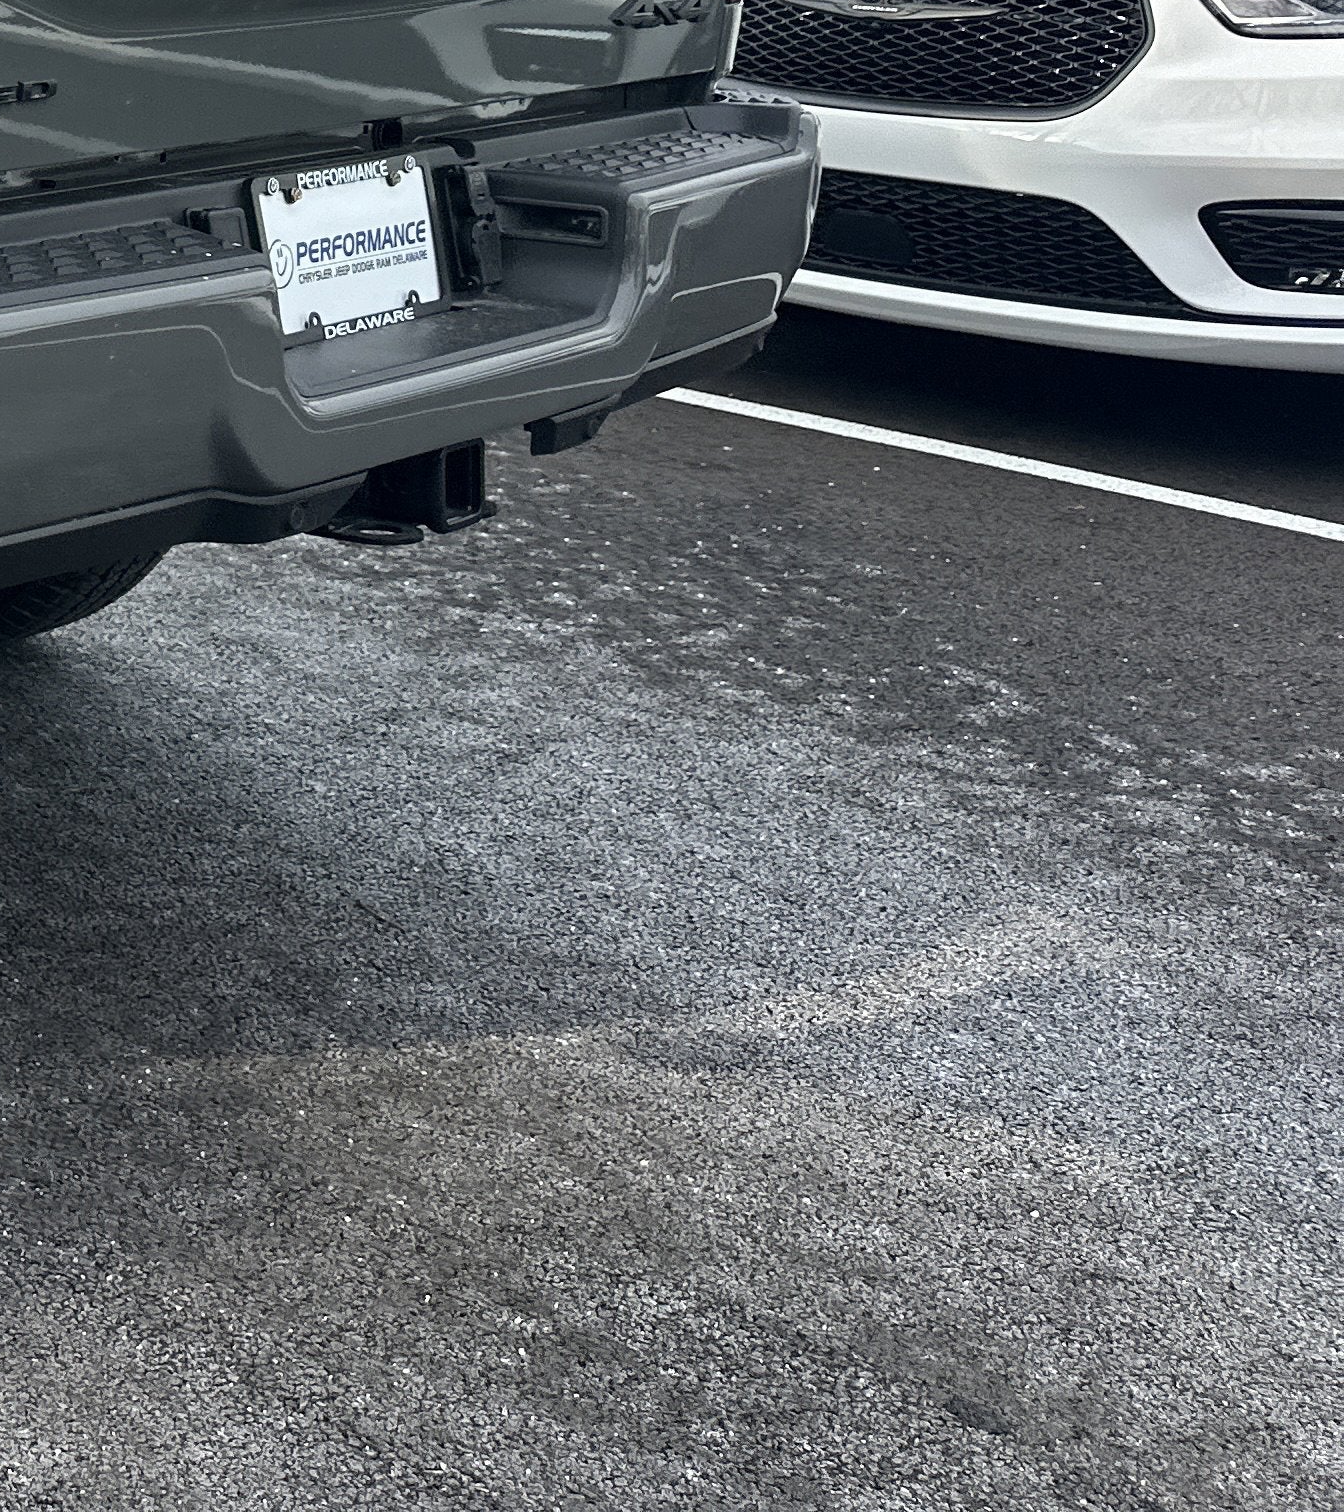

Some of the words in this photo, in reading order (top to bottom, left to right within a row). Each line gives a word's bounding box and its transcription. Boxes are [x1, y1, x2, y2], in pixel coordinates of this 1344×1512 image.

[295, 159, 389, 190] PERFORMANCE
[295, 219, 427, 267] PERFORMANCE
[298, 267, 333, 285] CHRYSLER
[334, 264, 351, 278] JEEP
[351, 260, 376, 275] DODGE
[376, 256, 392, 269] RAM
[392, 249, 429, 266] DELAWARE
[324, 306, 416, 340] DELAWARE
